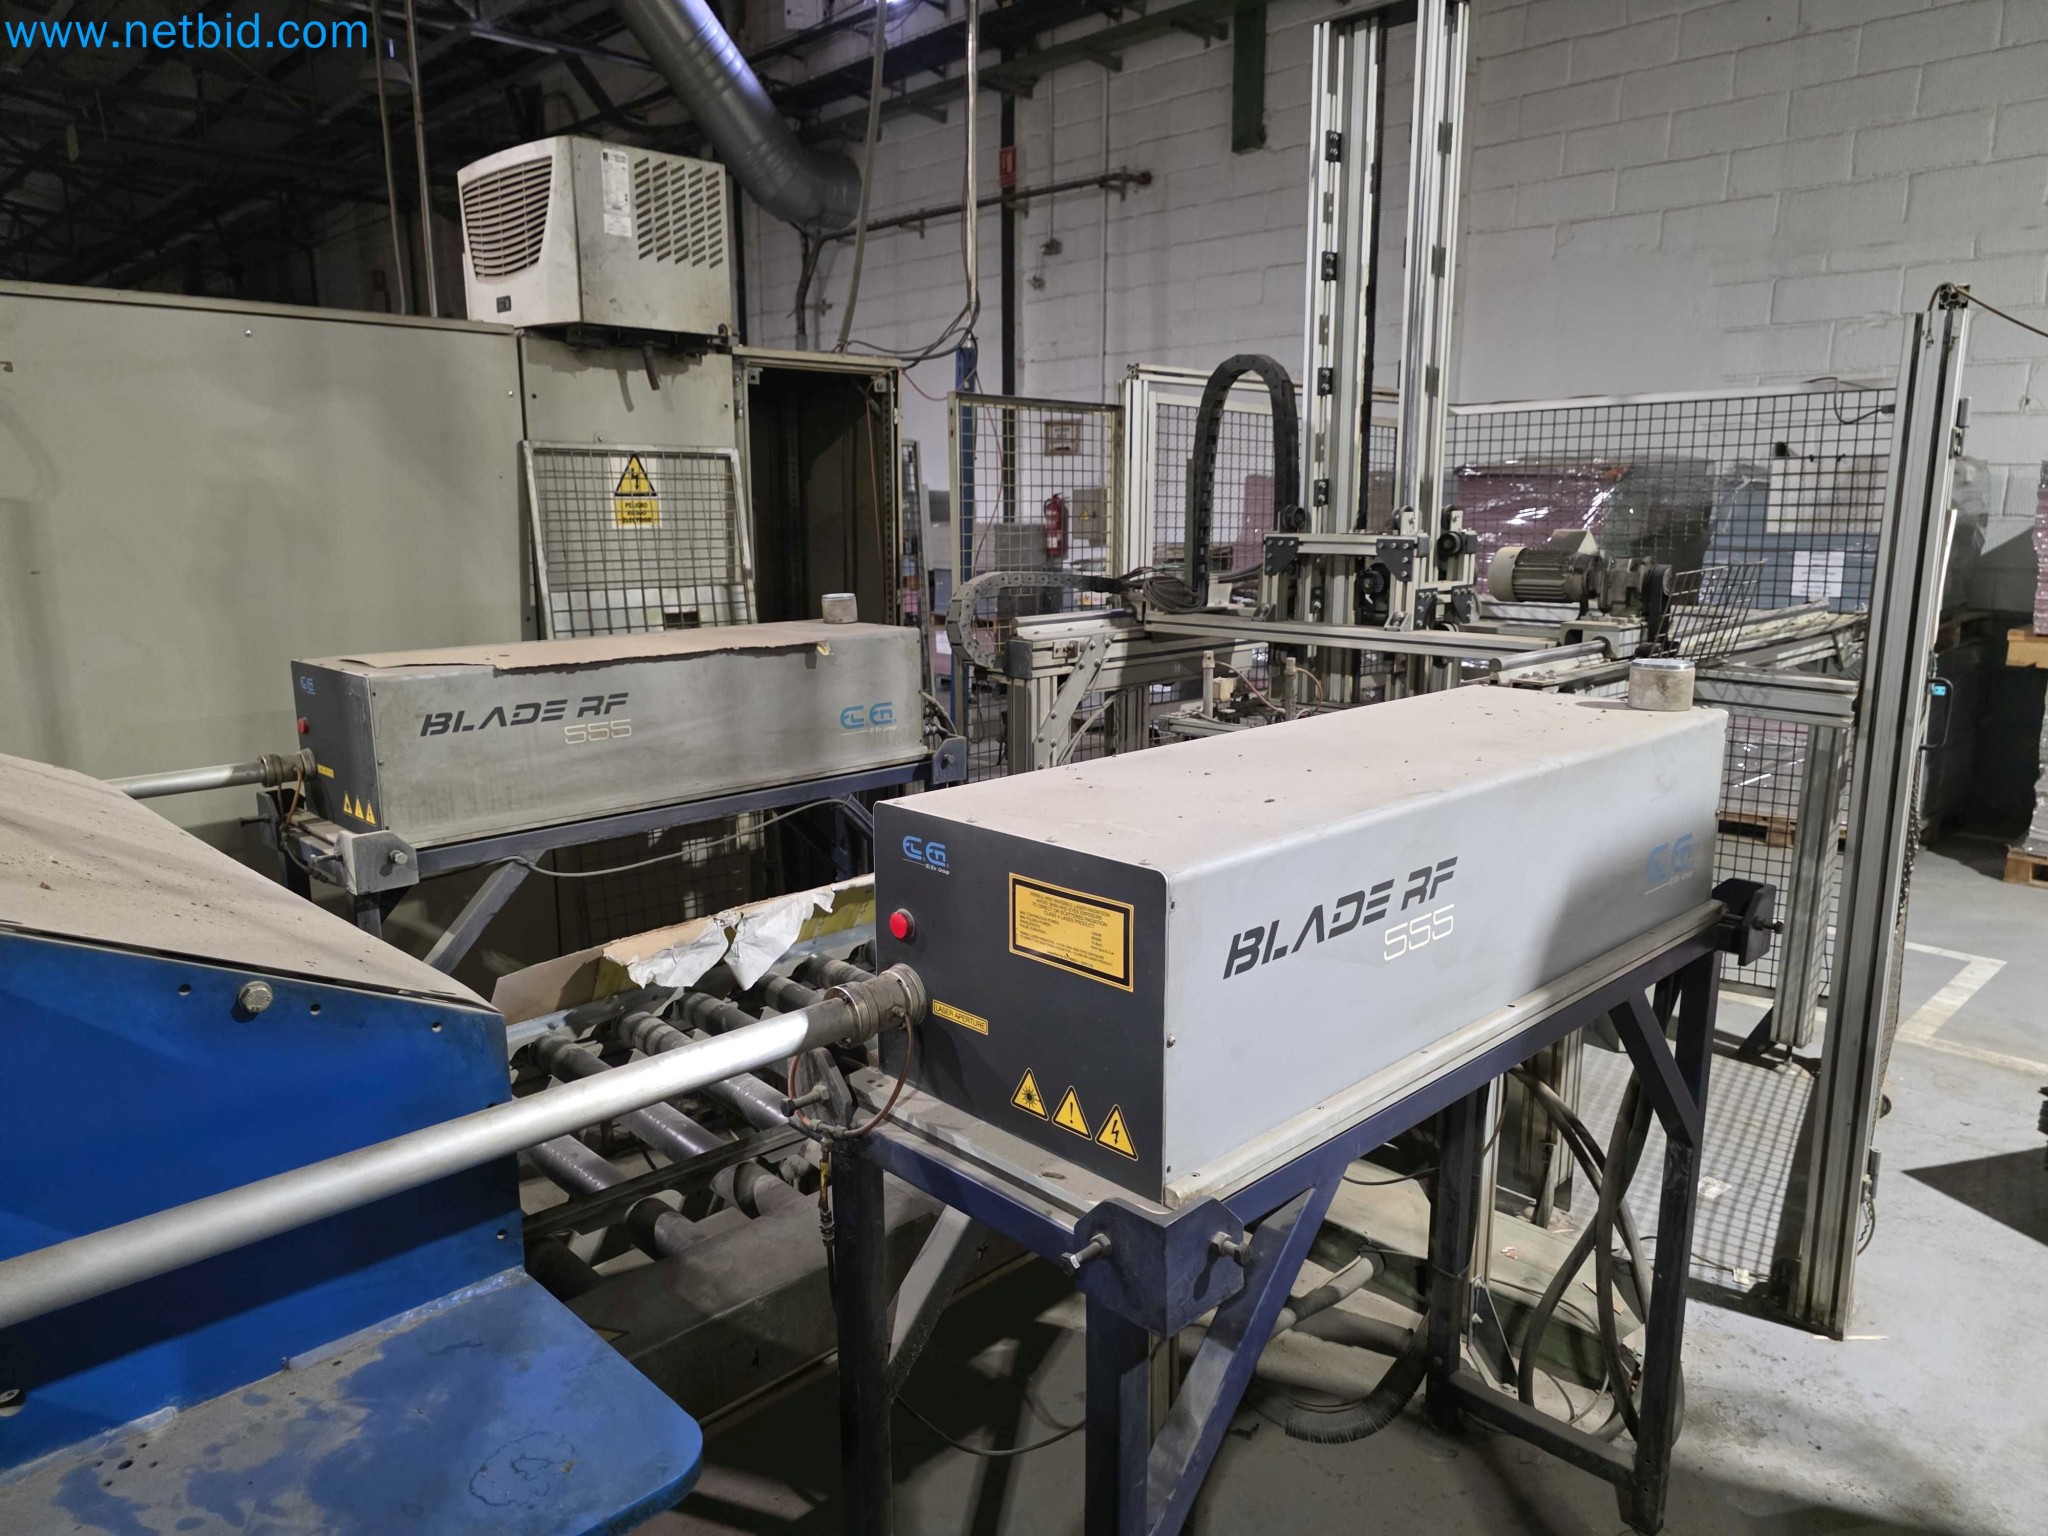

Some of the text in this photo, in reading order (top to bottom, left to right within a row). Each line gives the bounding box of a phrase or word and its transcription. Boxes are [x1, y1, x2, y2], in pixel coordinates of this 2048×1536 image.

[419, 692, 629, 738] BLADE RF
[564, 719, 632, 745] 555
[1223, 856, 1458, 979] BLADE RF
[1384, 903, 1455, 961] 555
[935, 1004, 986, 1030] LASER APERTURE
